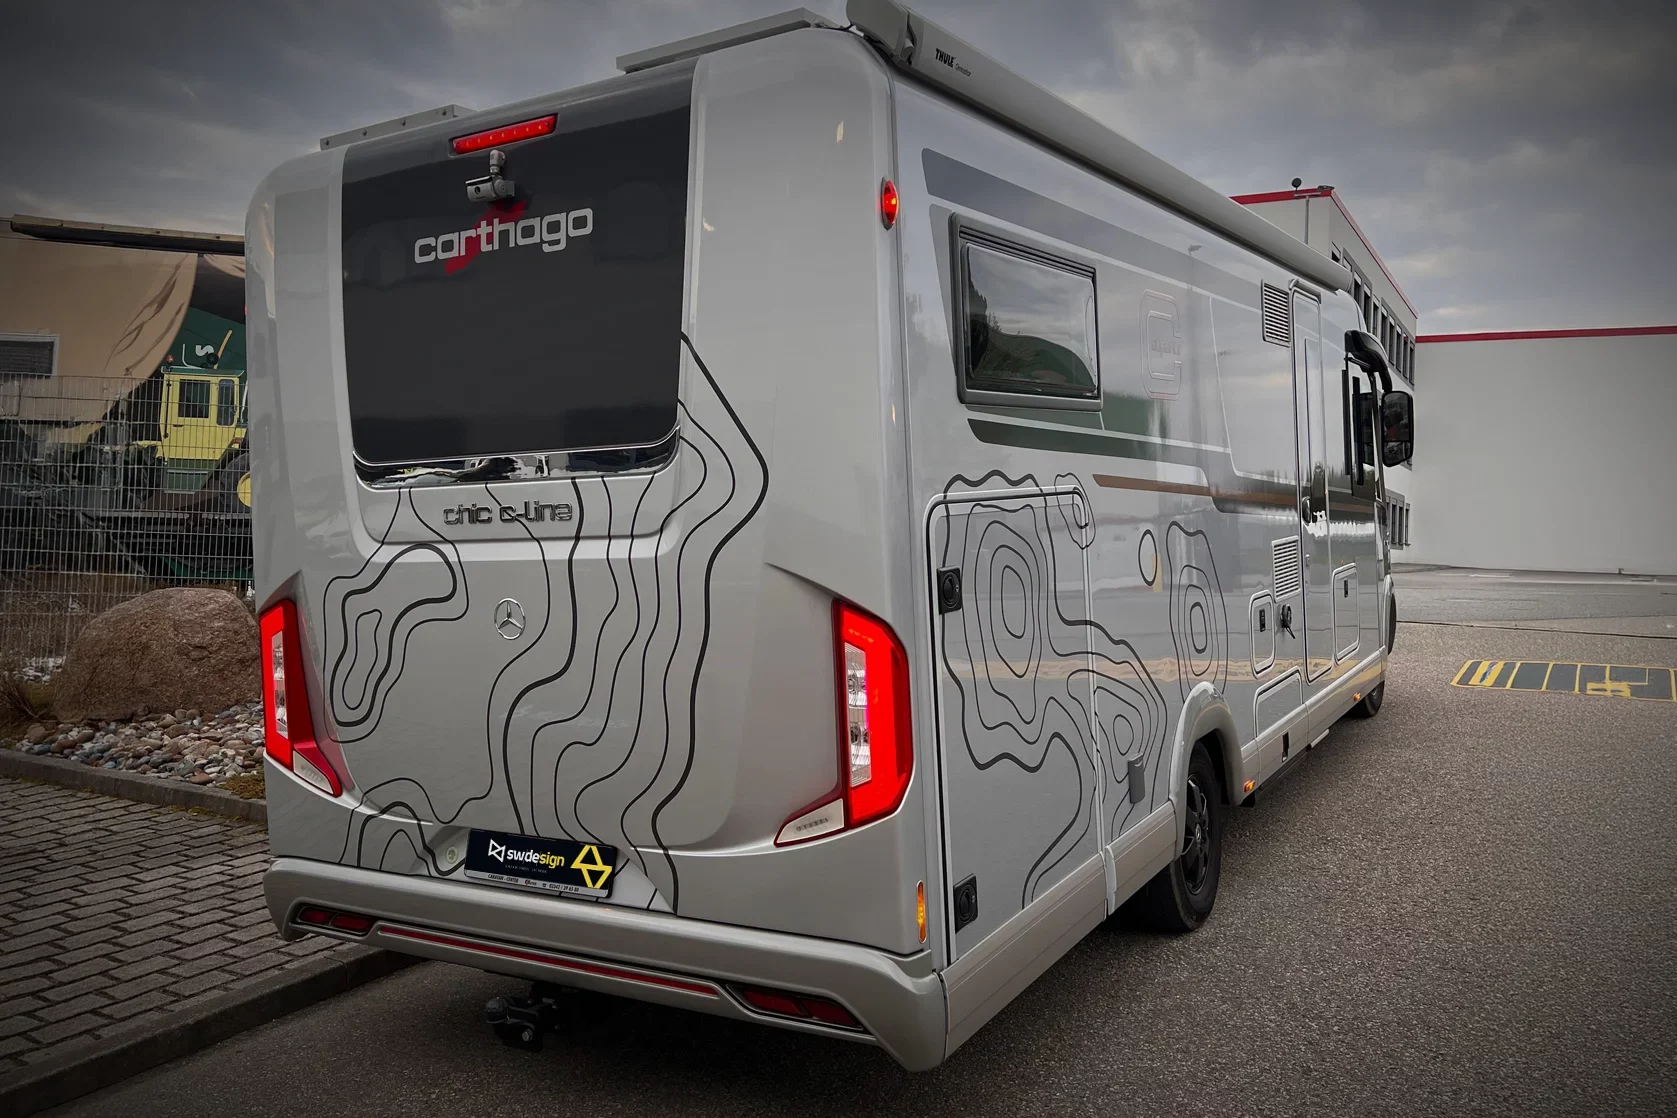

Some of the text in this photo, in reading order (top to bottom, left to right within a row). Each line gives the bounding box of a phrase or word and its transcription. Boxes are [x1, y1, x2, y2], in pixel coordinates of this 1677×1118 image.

[935, 48, 955, 68] THULE
[414, 207, 594, 264] carthago
[443, 500, 573, 525] chic c-line
[506, 849, 565, 868] swdesign
